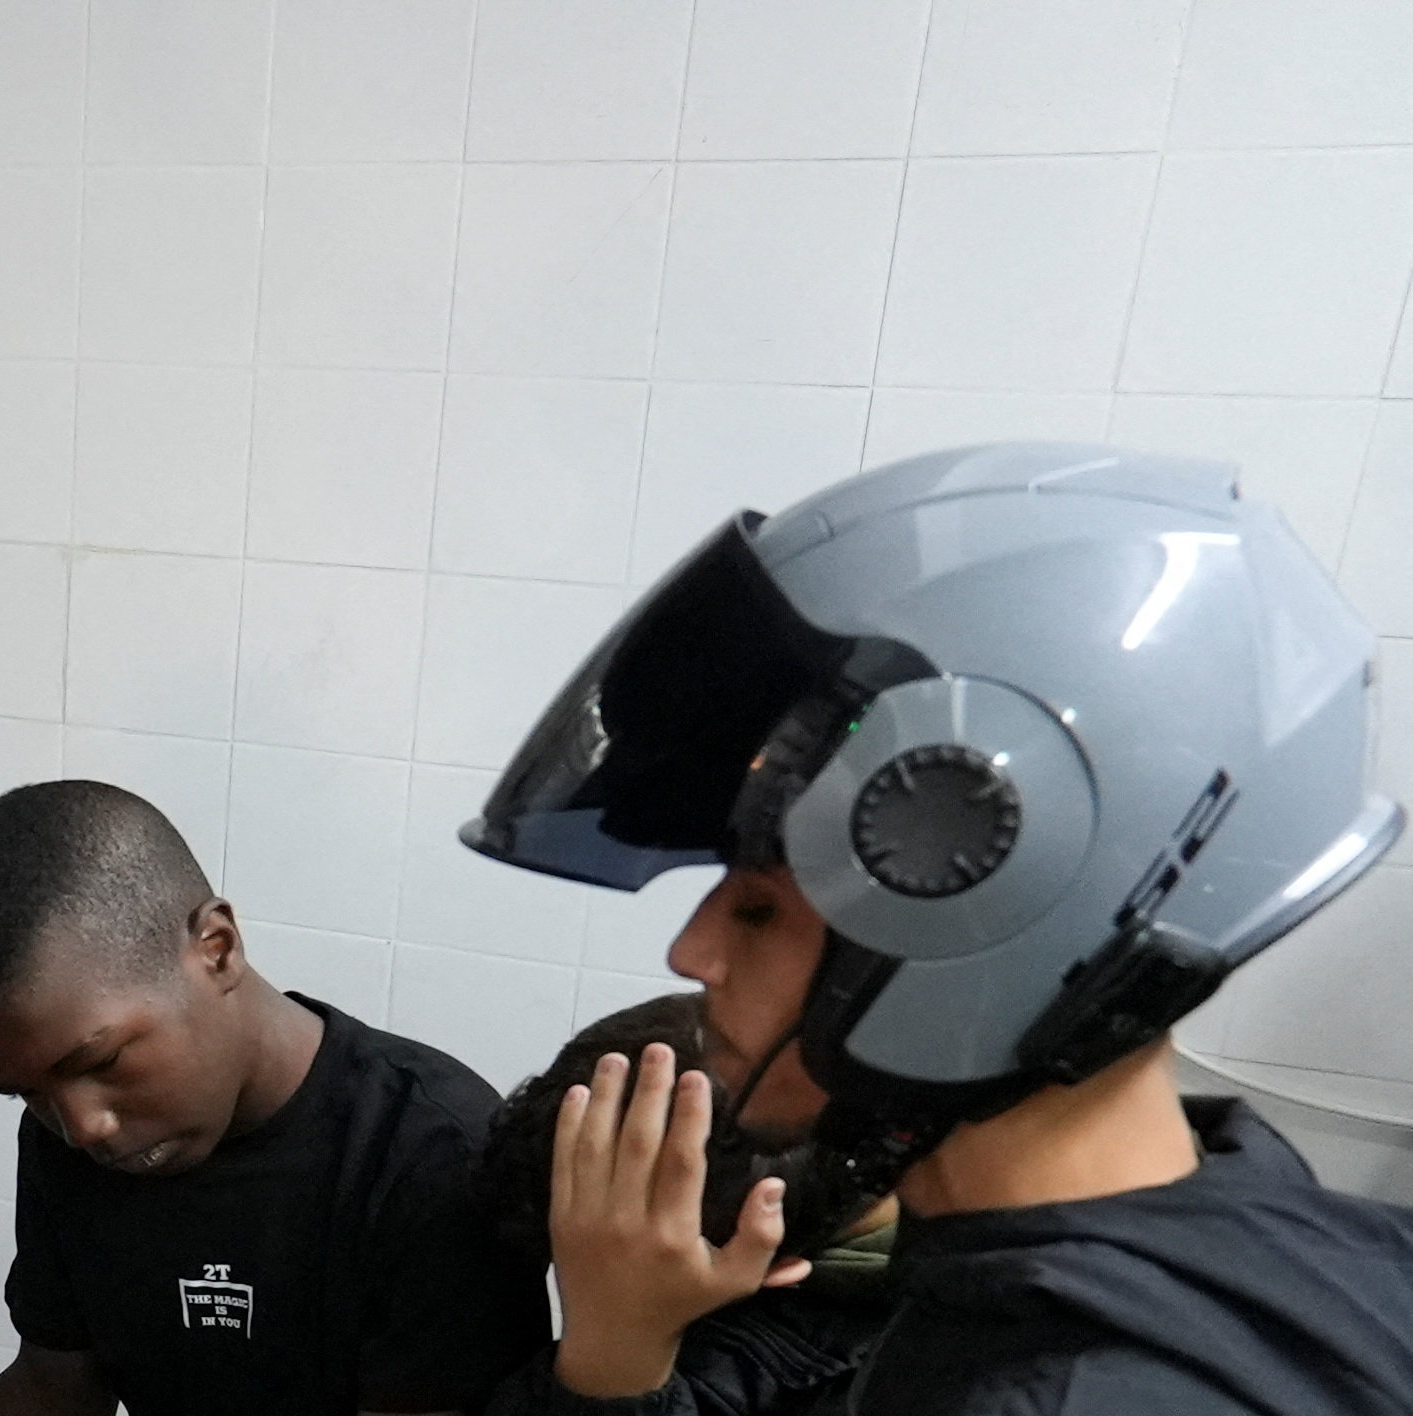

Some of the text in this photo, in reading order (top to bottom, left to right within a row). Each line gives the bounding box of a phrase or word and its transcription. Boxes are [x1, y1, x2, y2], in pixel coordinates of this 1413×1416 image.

[203, 1264, 231, 1280] 2T
[187, 1294, 212, 1304] THE
[214, 1305, 228, 1315] IS
[201, 1316, 241, 1328] IN YOU
